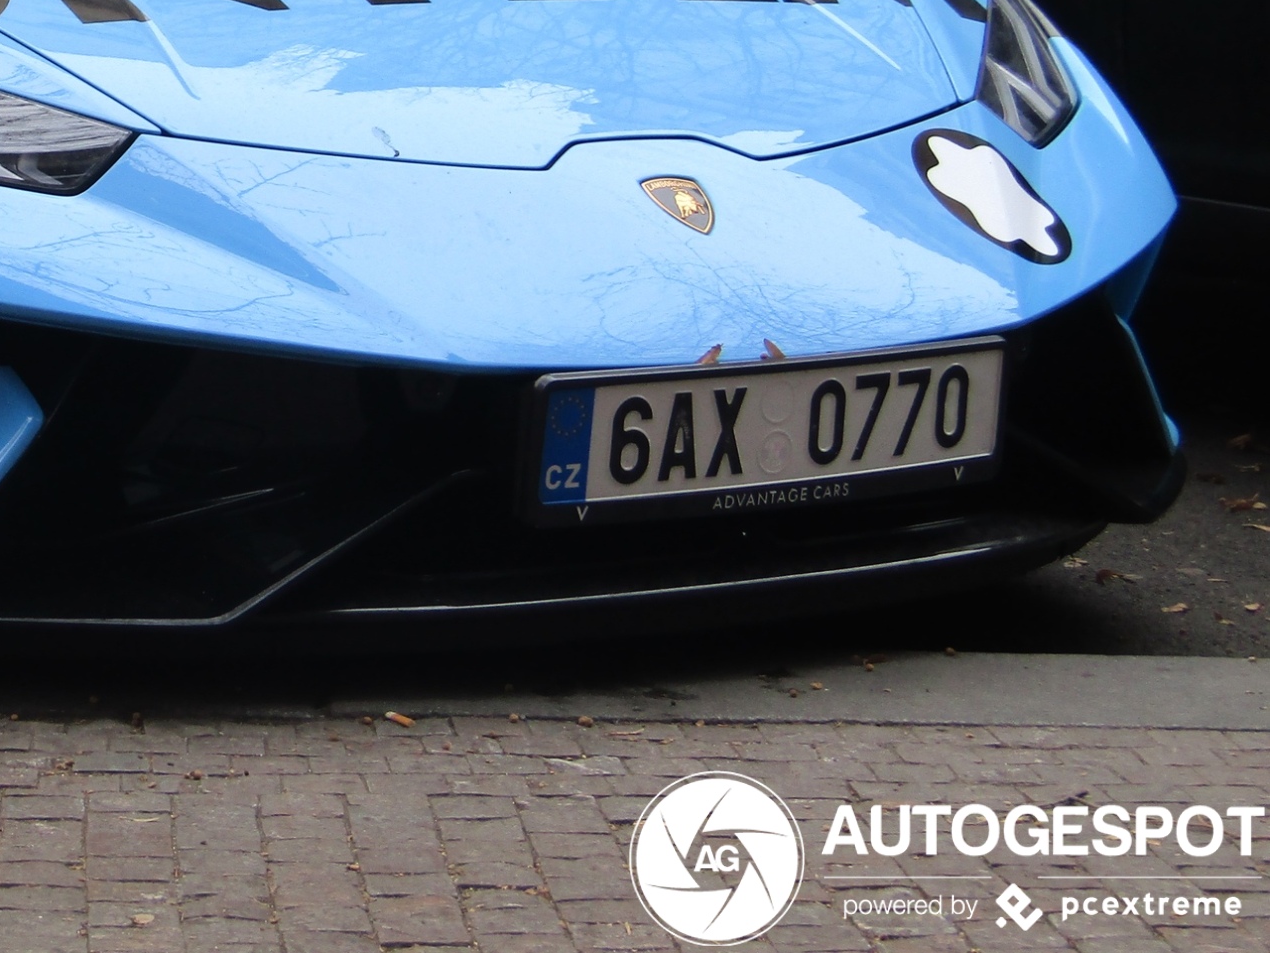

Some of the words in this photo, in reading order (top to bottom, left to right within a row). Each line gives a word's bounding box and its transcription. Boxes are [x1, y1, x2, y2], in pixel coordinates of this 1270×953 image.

[608, 386, 748, 485] 6AX
[807, 362, 970, 466] 0770
[545, 463, 581, 490] CZ
[713, 486, 808, 510] ADVANTAGE
[813, 482, 850, 500] CARS
